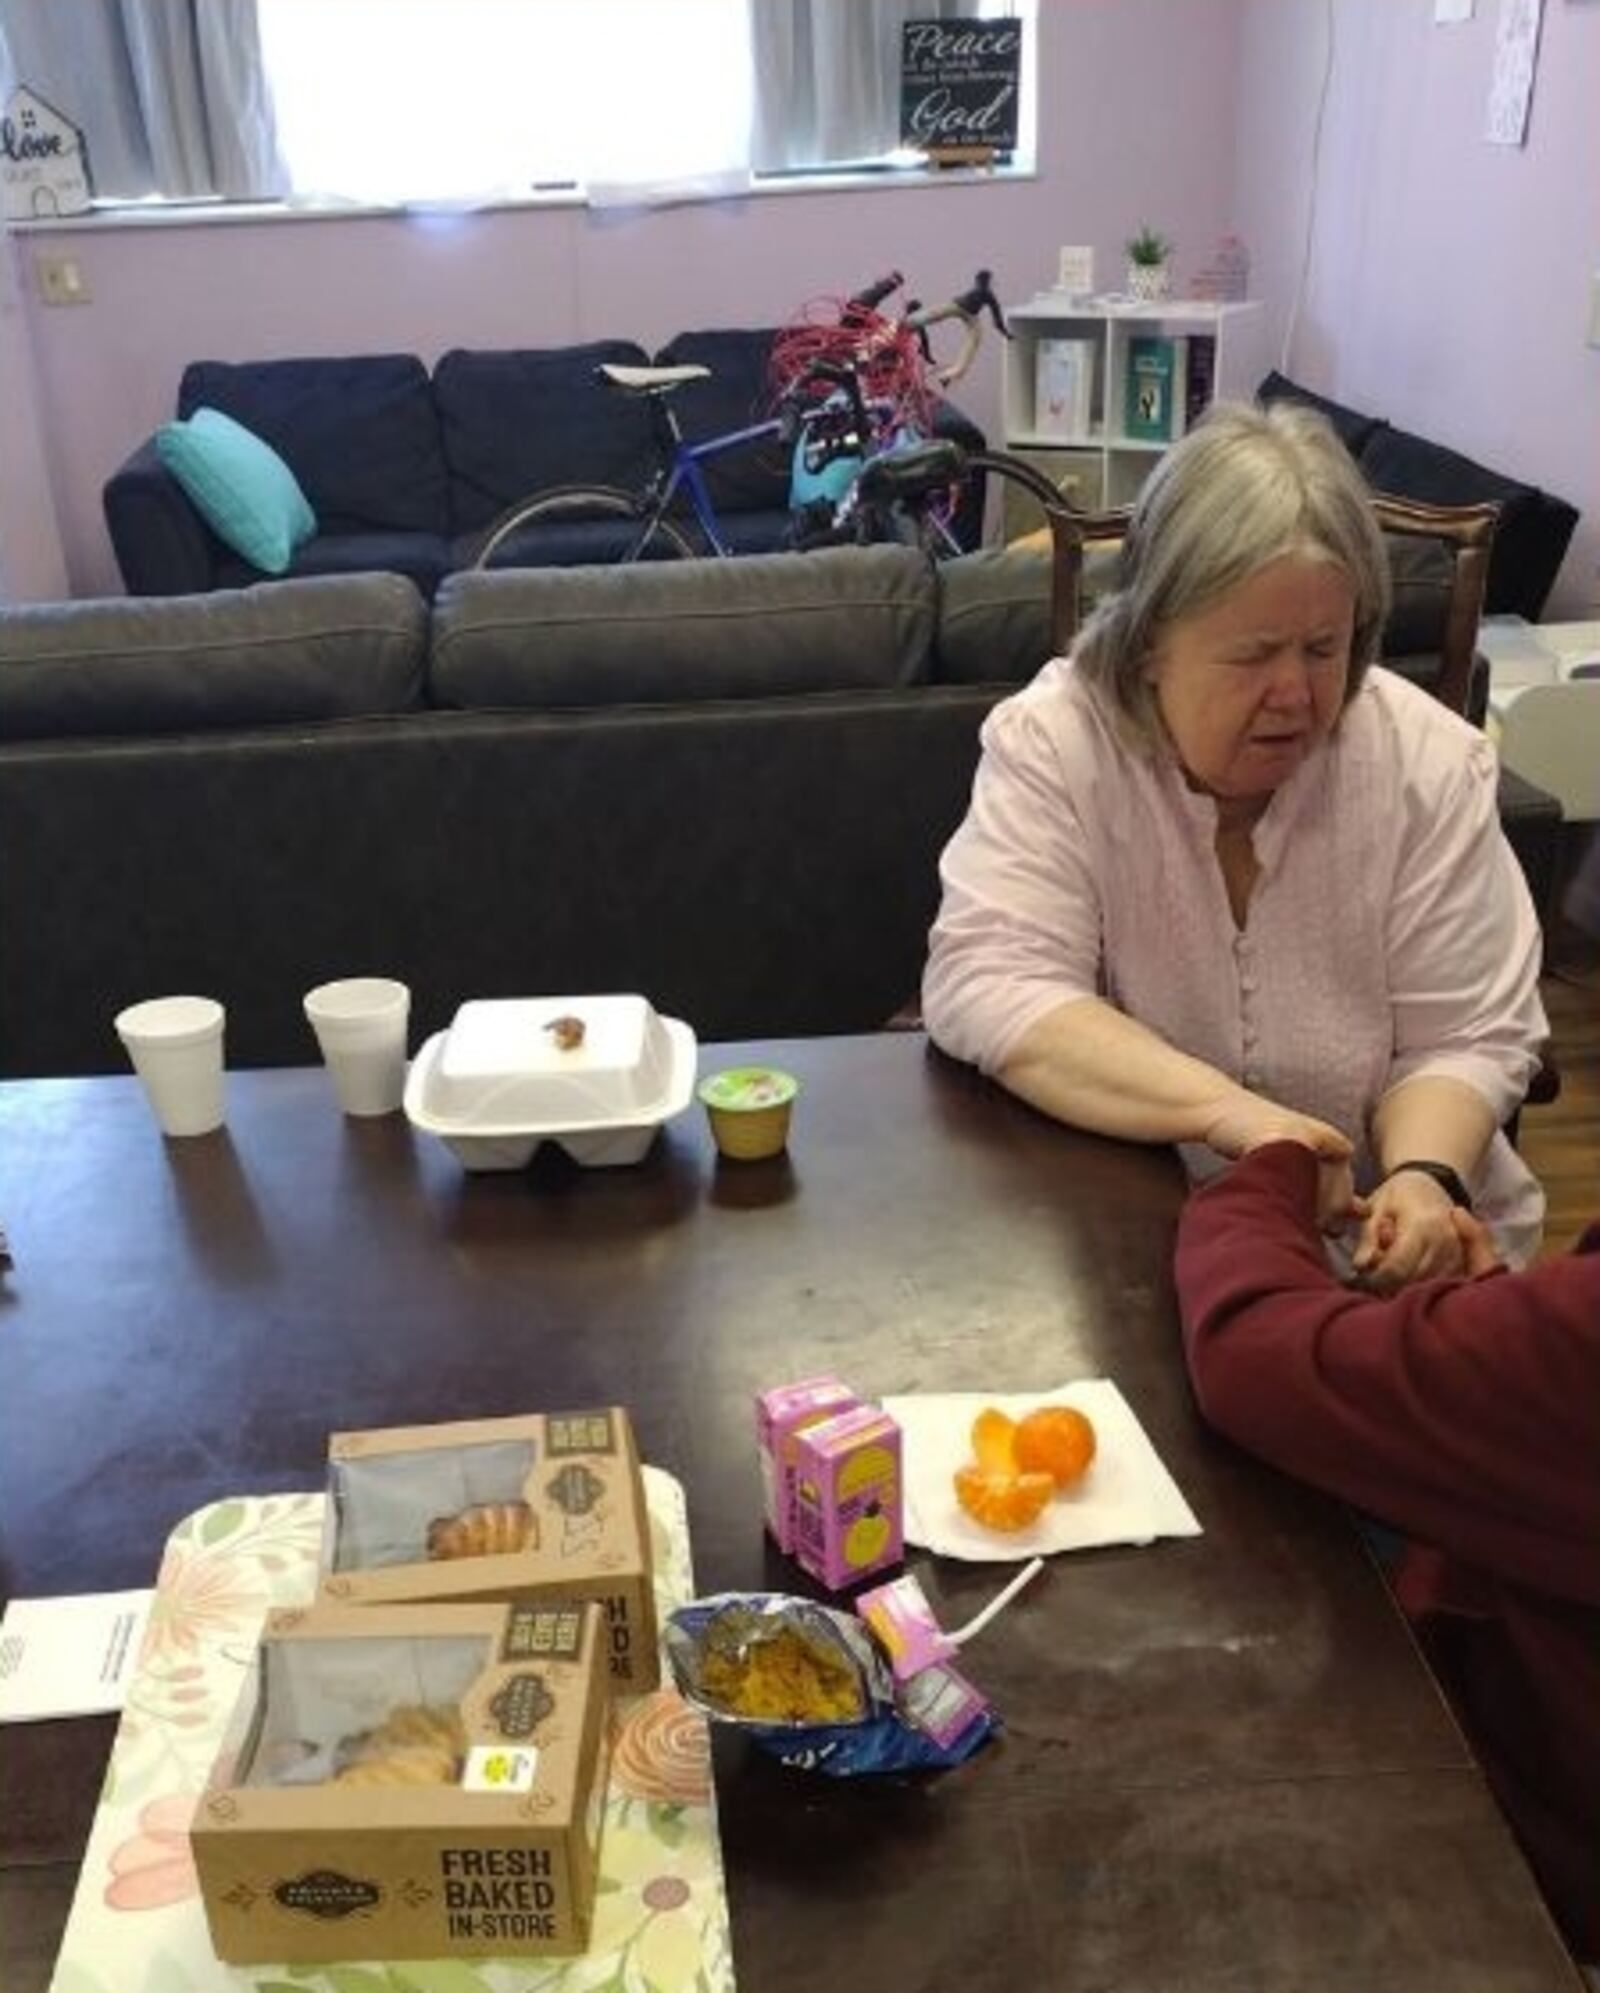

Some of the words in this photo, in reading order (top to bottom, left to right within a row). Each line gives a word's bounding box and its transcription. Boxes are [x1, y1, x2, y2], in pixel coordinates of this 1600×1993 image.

[906, 24, 1021, 60] Peace
[909, 85, 1014, 147] God
[1, 117, 68, 161] love
[441, 1849, 551, 1876] FRESH
[446, 1881, 555, 1910] BAKED
[449, 1914, 556, 1939] IN-STORE
